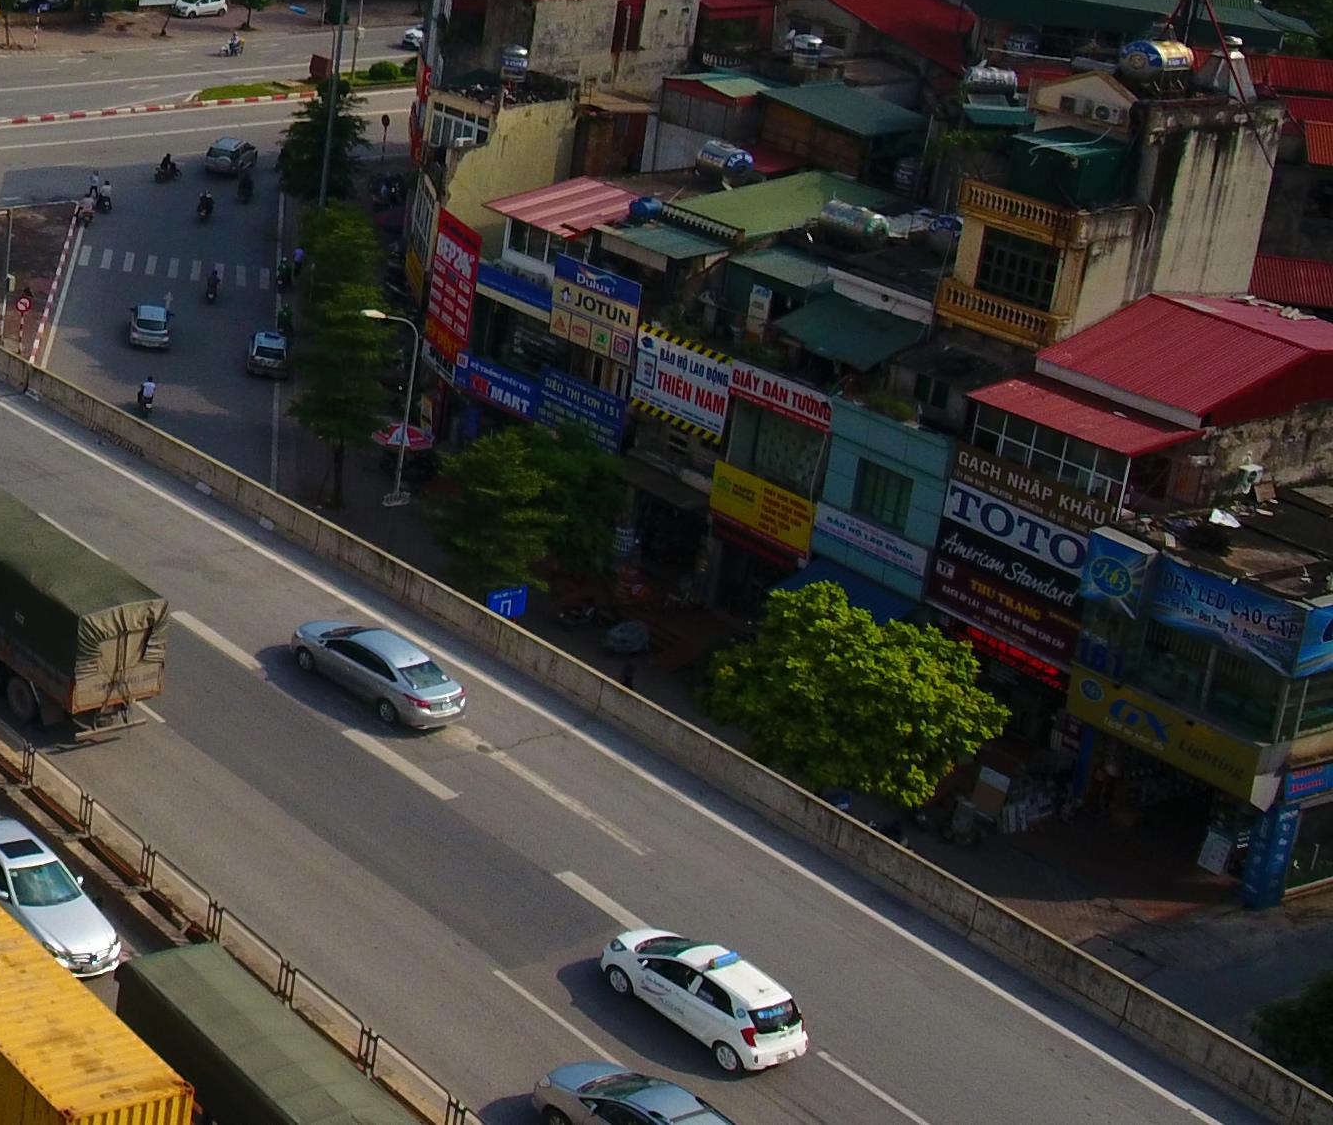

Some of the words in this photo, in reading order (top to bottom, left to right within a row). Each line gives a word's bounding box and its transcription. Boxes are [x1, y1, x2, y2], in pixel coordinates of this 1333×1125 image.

[575, 290, 631, 327] JOTUN
[689, 360, 705, 377] LAO
[732, 368, 760, 392] GIẤY
[763, 379, 789, 404] DÁN
[490, 385, 531, 414] MART
[657, 370, 693, 403] THIÊN
[694, 386, 726, 417] NAM
[957, 450, 1002, 481] GẠCH
[1007, 471, 1054, 502] NHẬP
[1058, 493, 1106, 526] KHẨU
[949, 484, 1087, 571] TOTO
[941, 532, 1006, 579] American
[1004, 561, 1077, 608] Standard
[997, 591, 1042, 621] TRANG
[1196, 585, 1227, 610] LED
[1230, 599, 1262, 625] CAO
[1177, 737, 1247, 781] Lighting
